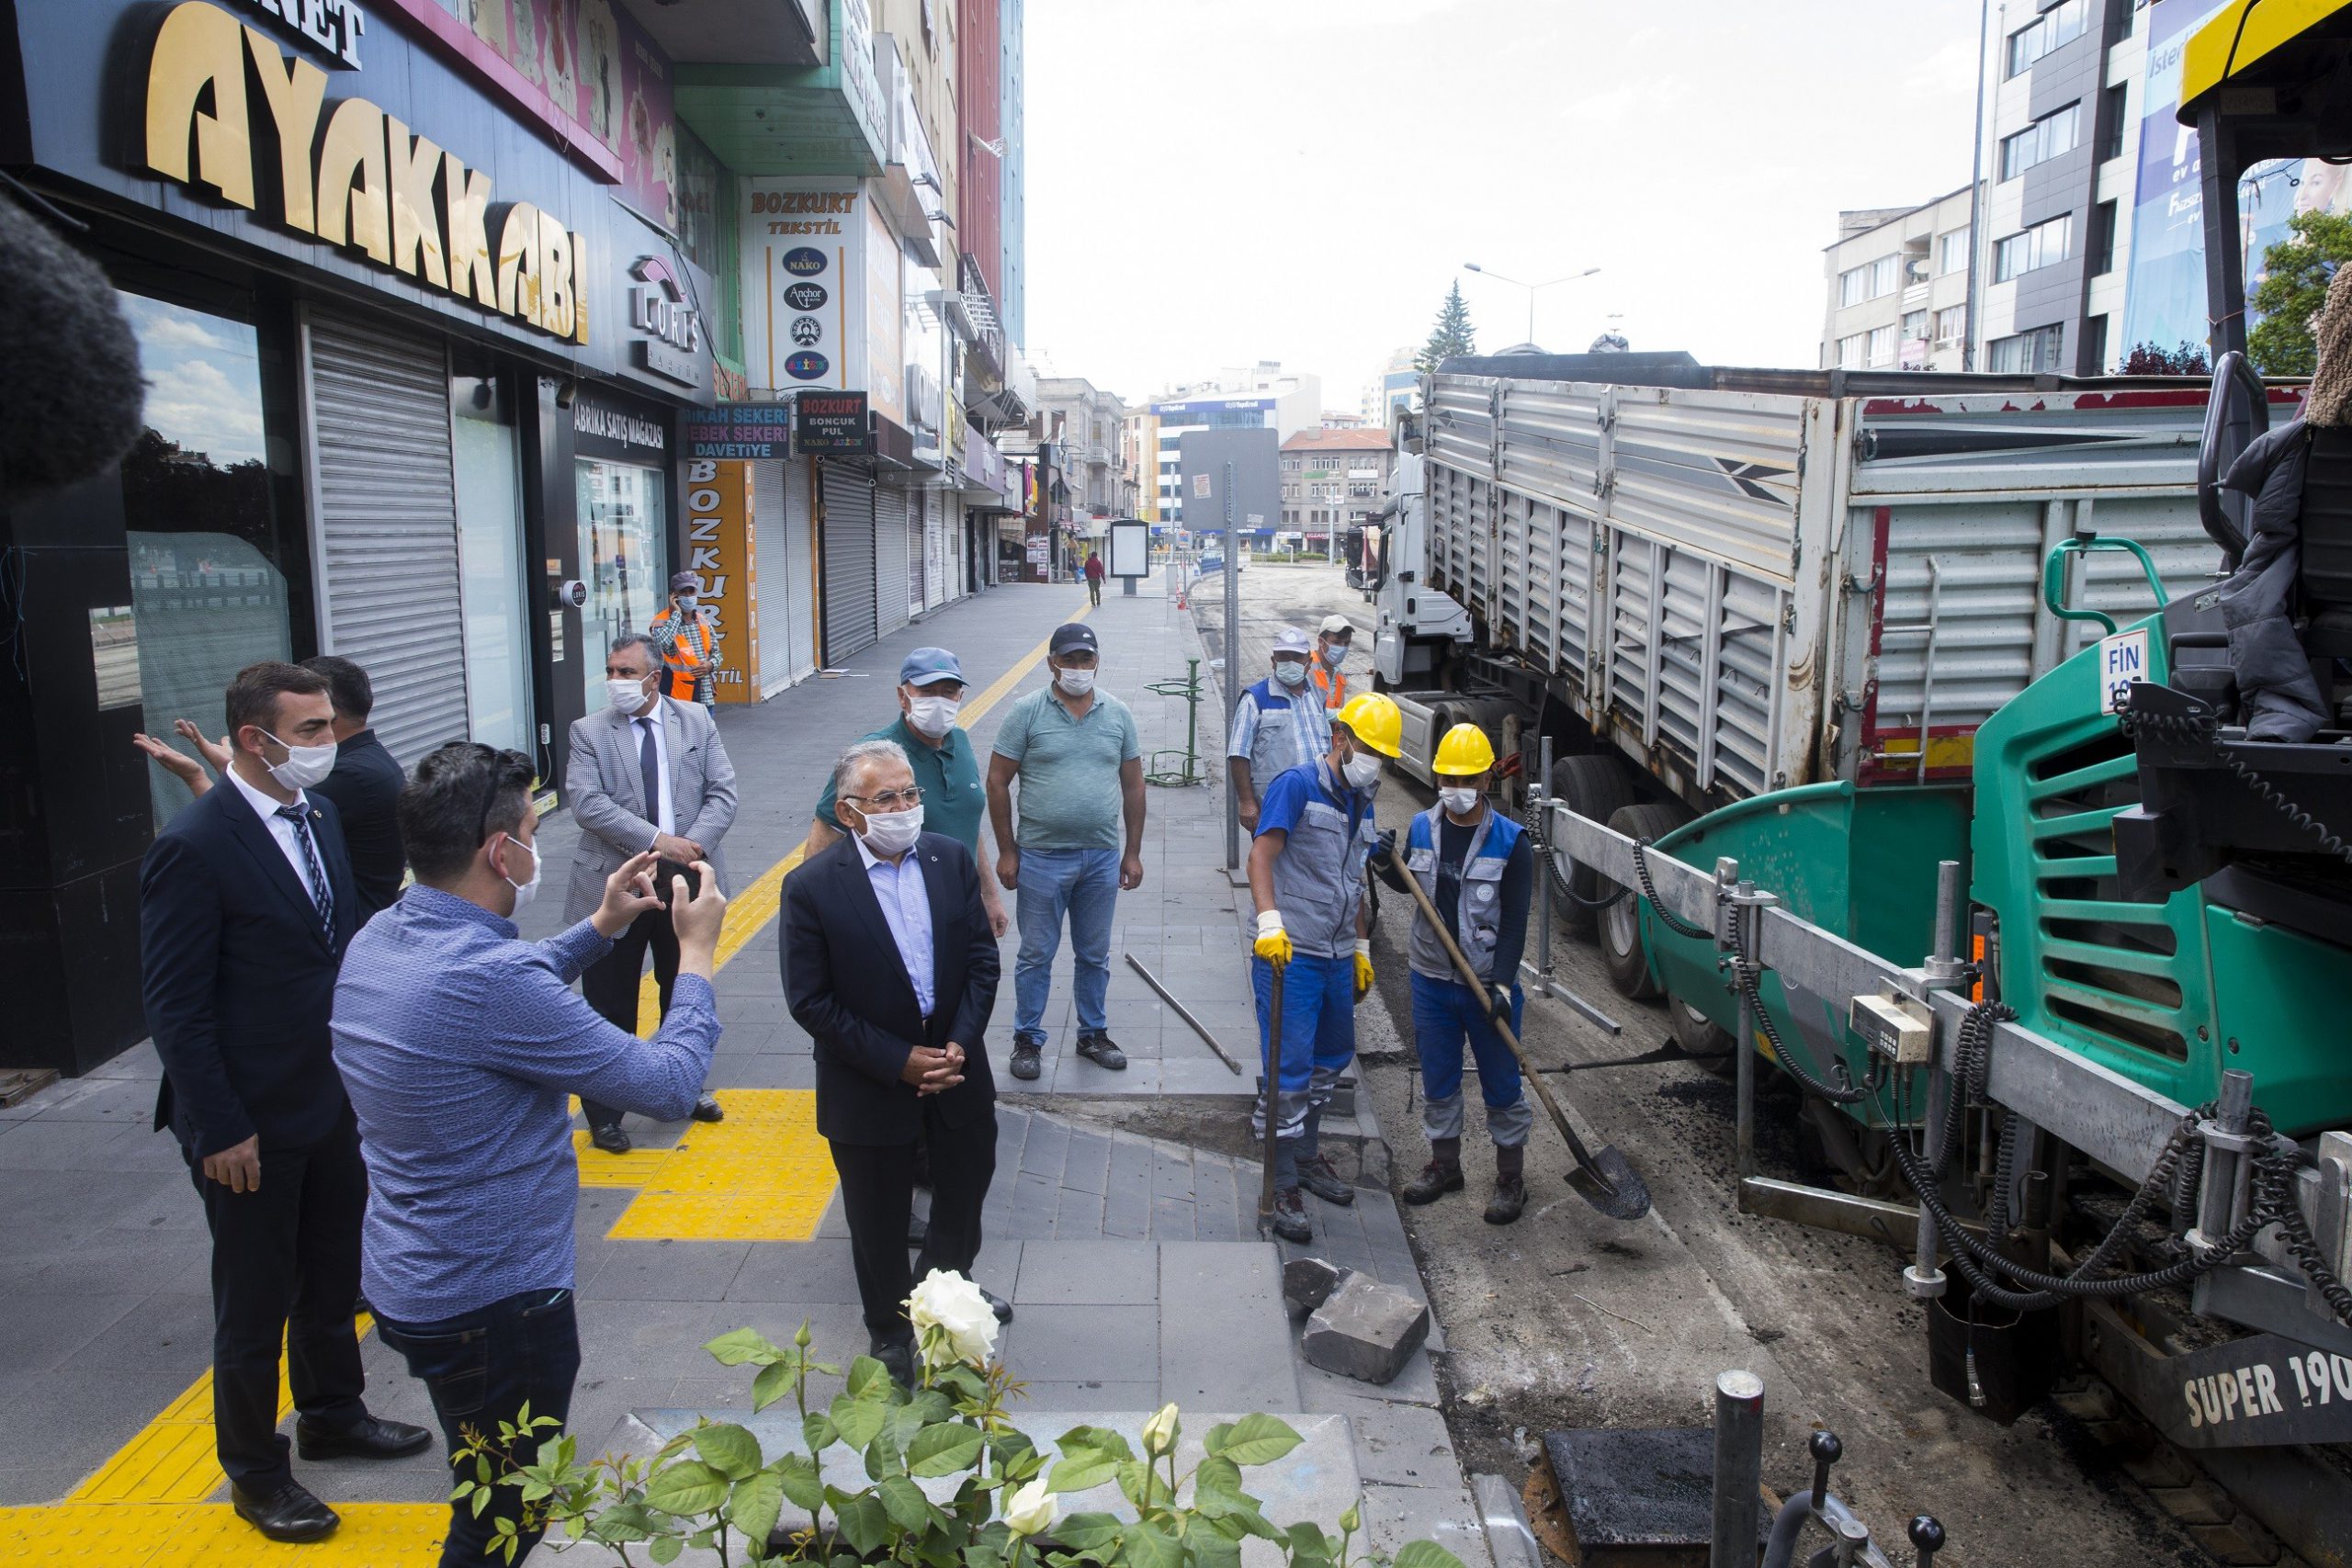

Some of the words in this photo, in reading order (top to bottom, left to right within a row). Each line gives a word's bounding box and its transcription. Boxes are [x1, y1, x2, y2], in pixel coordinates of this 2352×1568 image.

[146, 0, 589, 346] AYAKKABI
[751, 191, 858, 214] BOZKURT
[767, 218, 842, 235] TEKSTİL
[790, 261, 820, 271] NAKO
[790, 287, 822, 299] Anchor
[636, 288, 700, 353] LORIS
[802, 399, 863, 414] BOZKURT
[574, 399, 606, 437] ABRİKA
[606, 411, 628, 448] SATIŞ
[628, 413, 663, 449] MAĞAZASI
[809, 418, 856, 426] BONCUK
[689, 425, 729, 442] EBEK
[822, 427, 843, 435] PUL
[804, 438, 830, 446] NAKO
[688, 461, 729, 640] BOZKUR
[745, 465, 758, 659] BOZKURT
[572, 591, 585, 599] LORIS
[2109, 641, 2140, 674] FİN
[711, 666, 744, 684] STİL
[2184, 1363, 2284, 1428] SUPER
